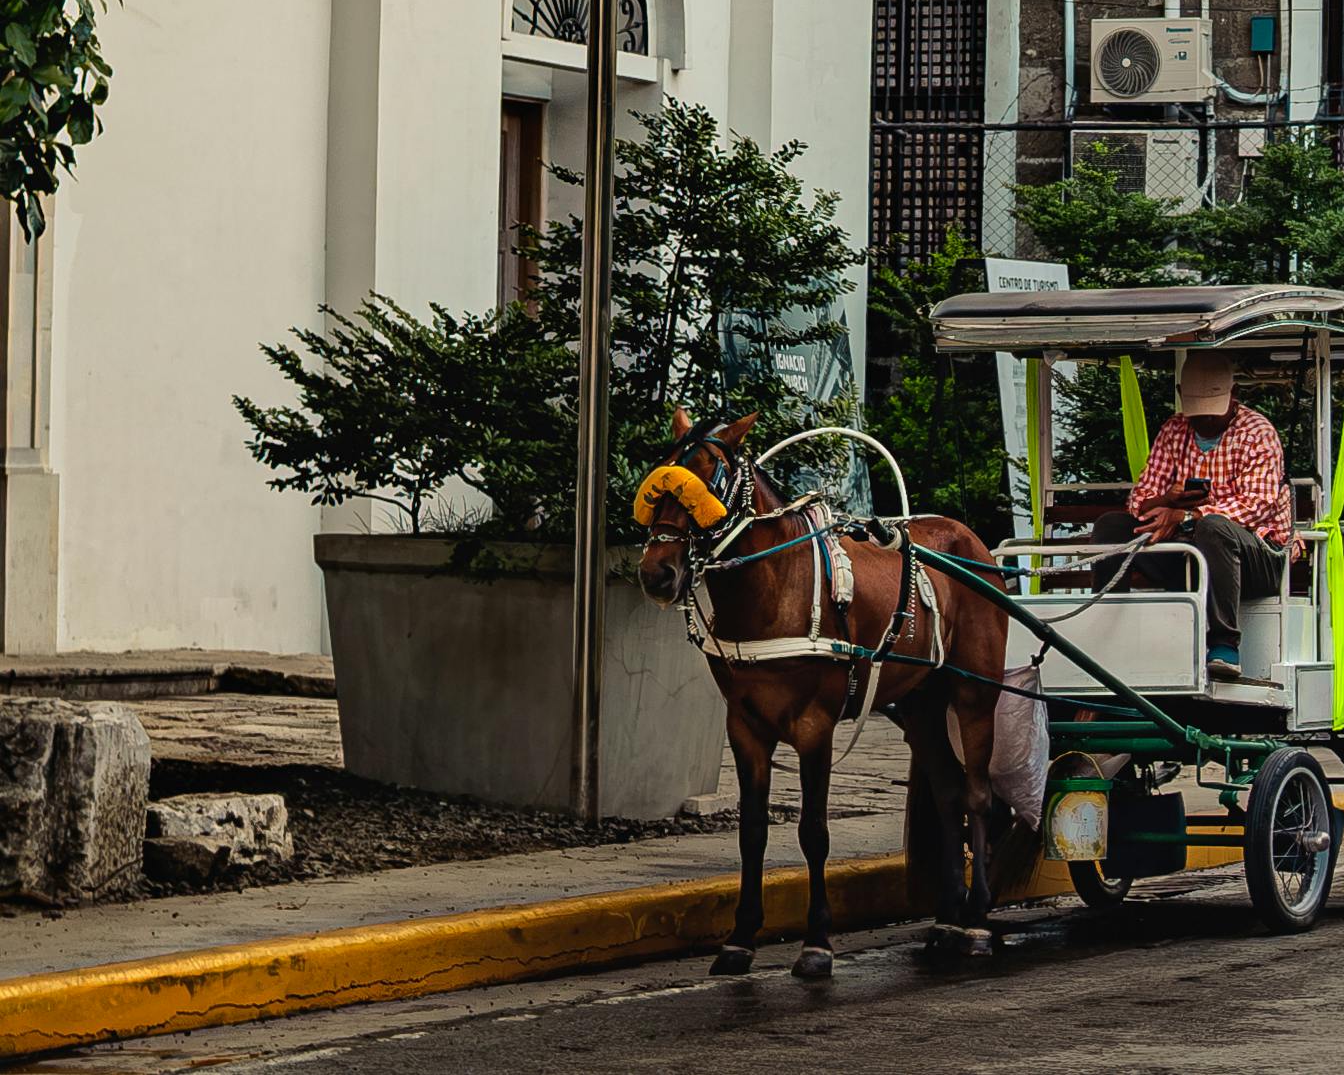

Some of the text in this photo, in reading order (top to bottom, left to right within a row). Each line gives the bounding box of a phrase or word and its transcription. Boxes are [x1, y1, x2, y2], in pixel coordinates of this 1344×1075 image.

[998, 276, 1023, 290] CENTRO
[1023, 278, 1032, 290] DE
[775, 352, 806, 373] IGNACIO
[779, 372, 809, 393] HURCH
